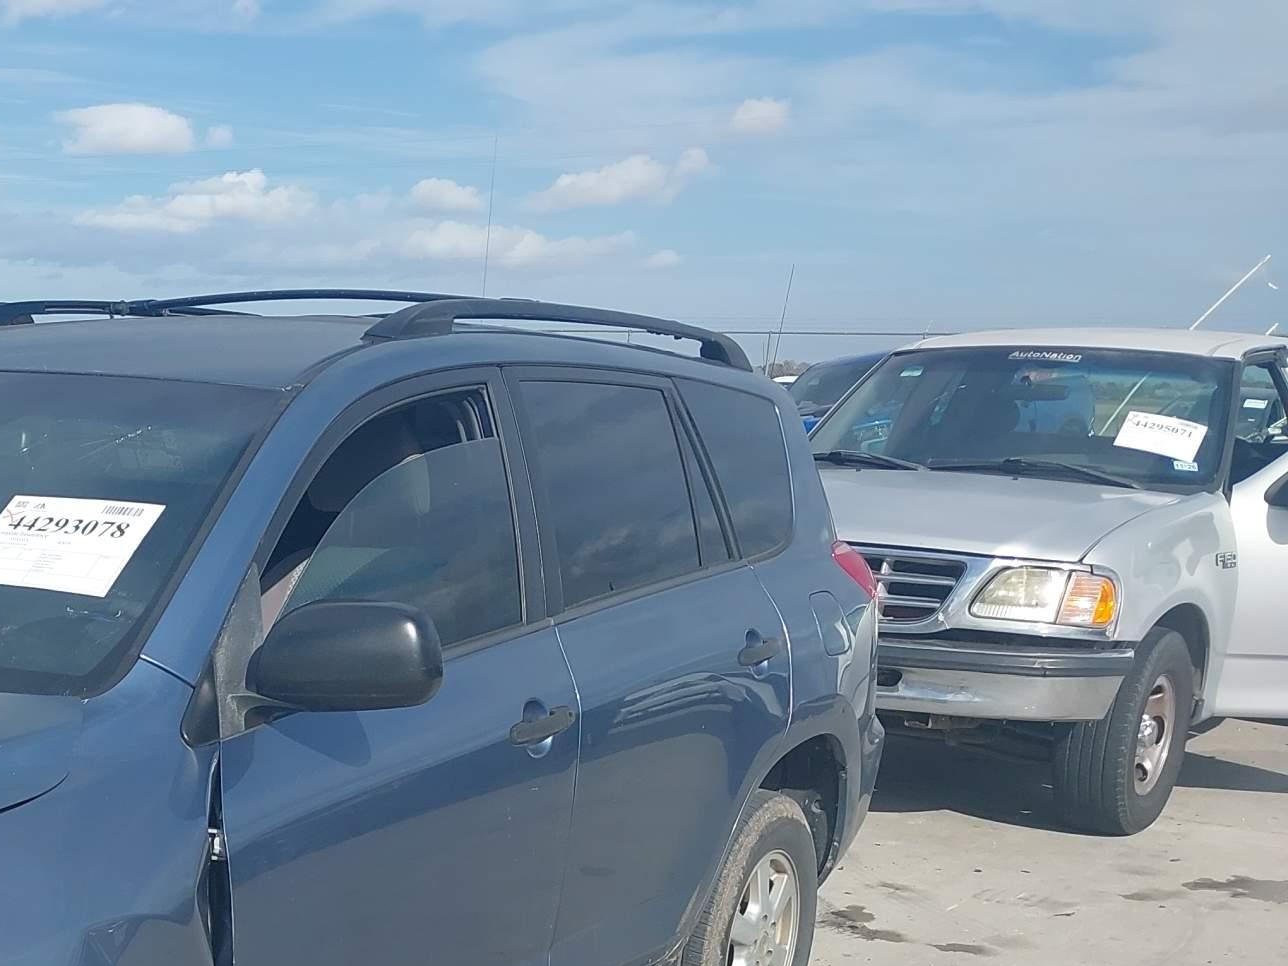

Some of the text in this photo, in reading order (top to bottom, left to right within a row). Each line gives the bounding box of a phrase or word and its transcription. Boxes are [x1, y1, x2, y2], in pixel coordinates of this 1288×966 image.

[1007, 350, 1083, 361] AutoNation
[1134, 419, 1193, 438] 44295071
[8, 514, 131, 539] 44293078
